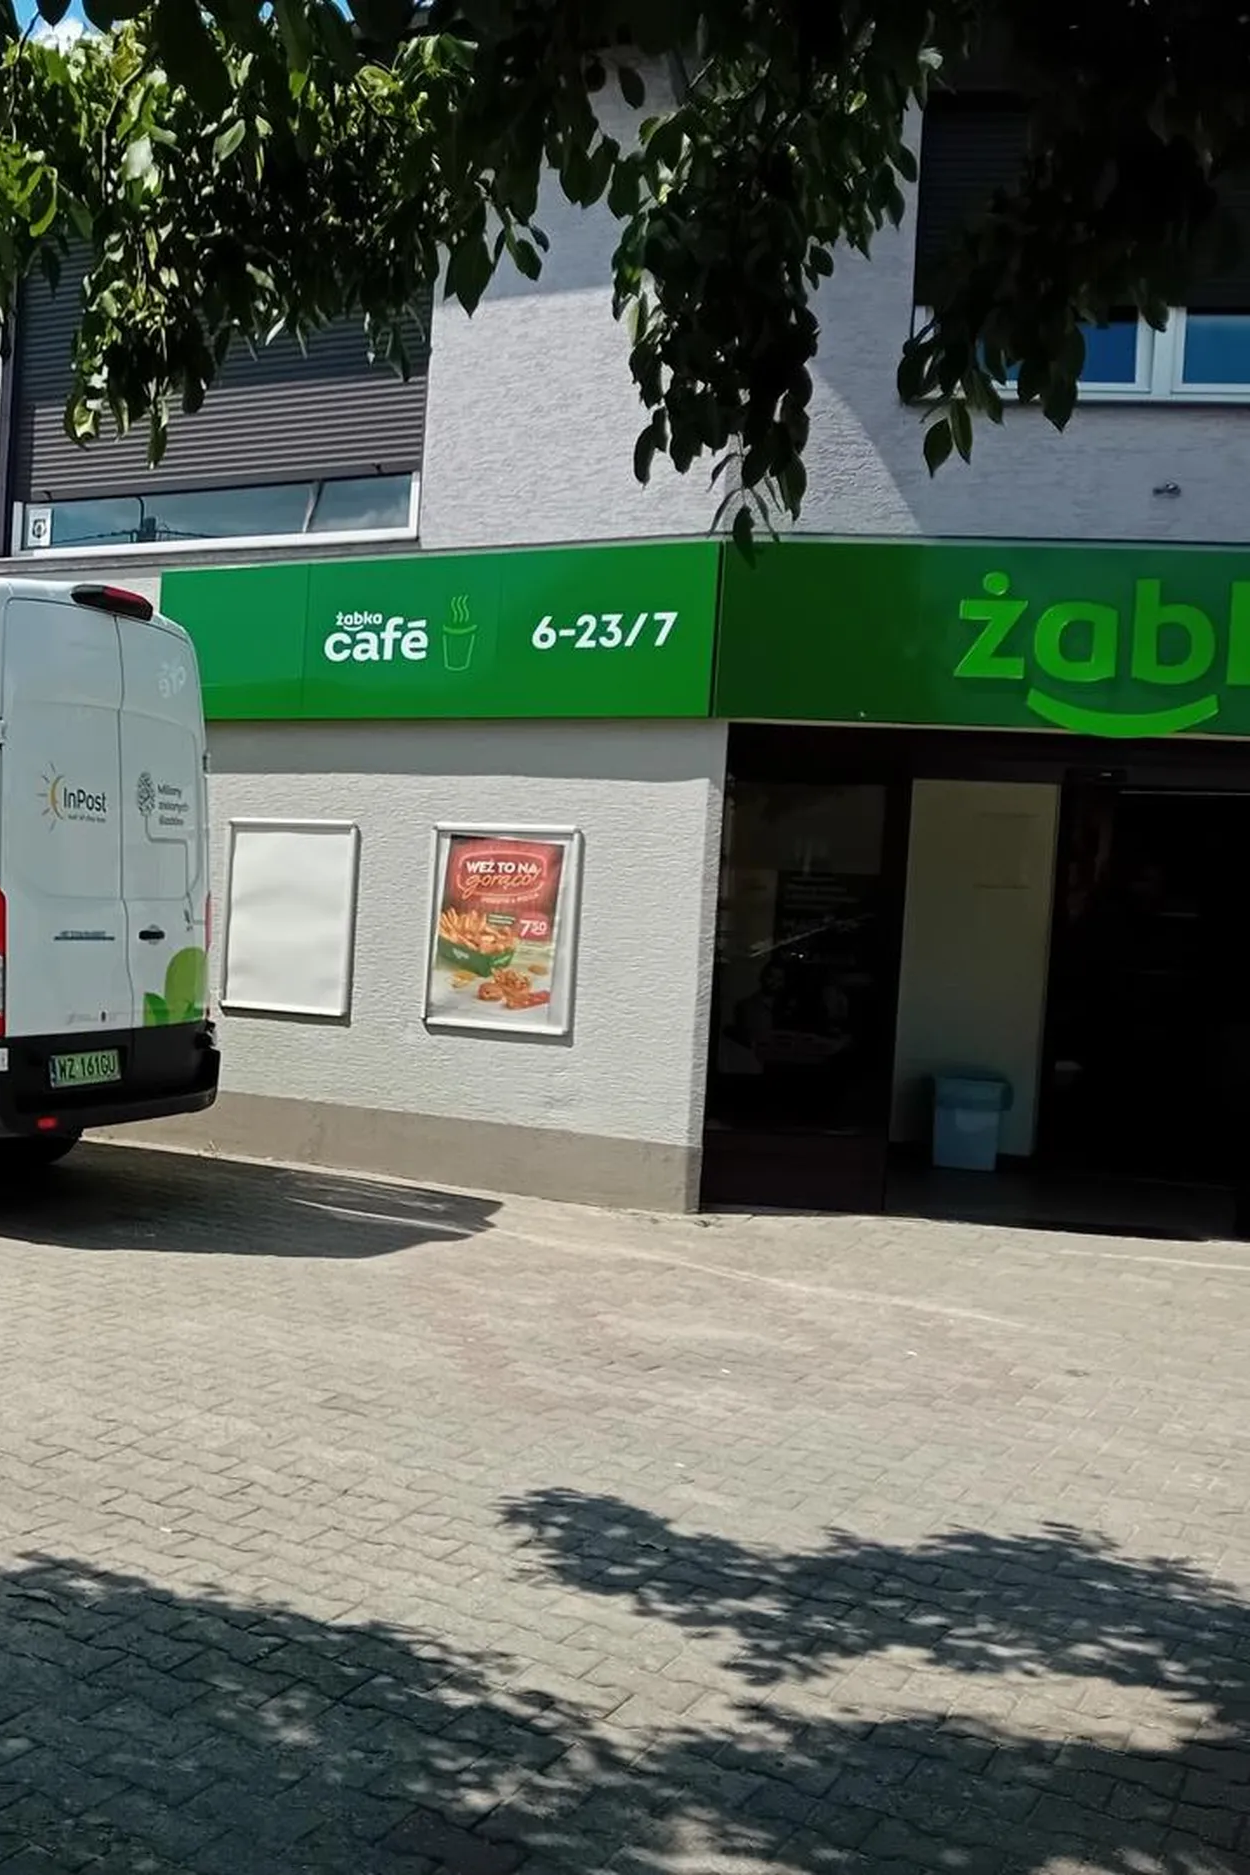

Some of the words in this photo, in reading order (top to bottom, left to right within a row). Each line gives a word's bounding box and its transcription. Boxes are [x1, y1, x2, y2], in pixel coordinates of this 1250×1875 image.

[324, 616, 429, 662] café
[531, 612, 678, 649] 6-23/7
[63, 787, 107, 812] InPost
[497, 862, 516, 874] TO
[517, 862, 538, 874] NA
